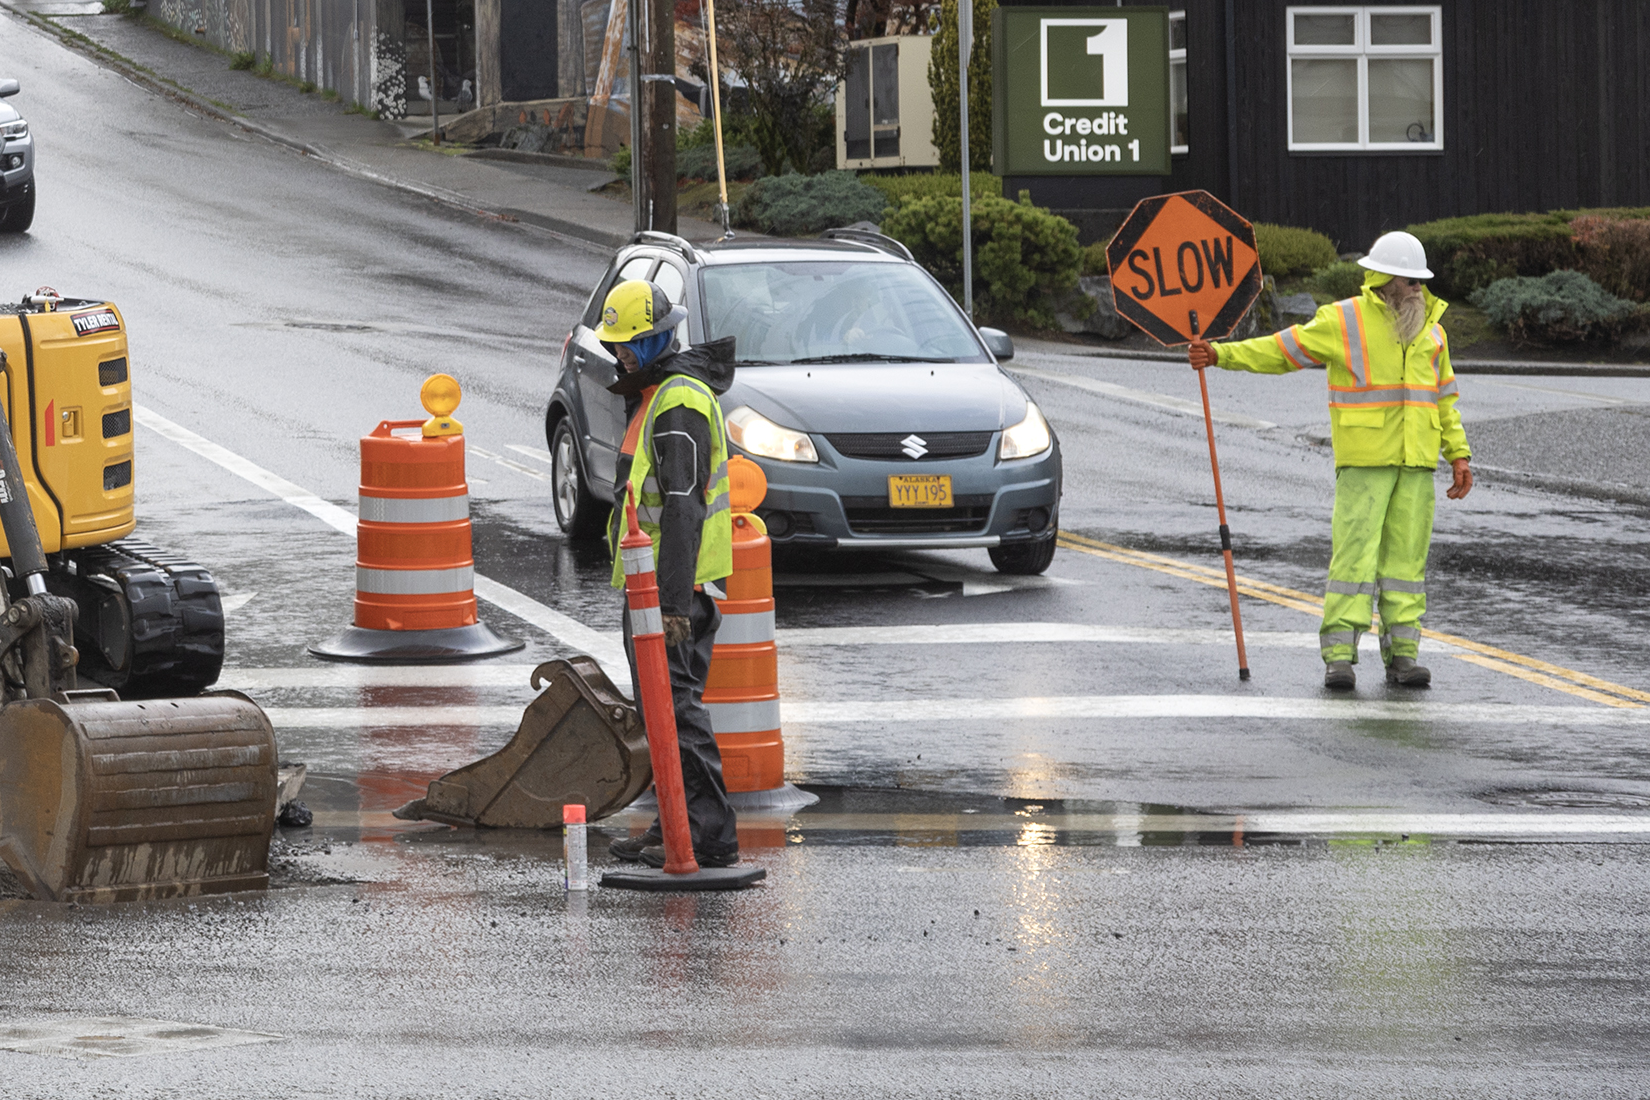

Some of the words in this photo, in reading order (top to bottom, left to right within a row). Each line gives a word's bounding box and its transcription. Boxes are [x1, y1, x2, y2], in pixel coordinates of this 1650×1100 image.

[1043, 111, 1129, 135] Credit
[1043, 138, 1121, 162] Union
[1127, 138, 1140, 162] 1
[1127, 235, 1234, 301] SLOW
[73, 314, 100, 332] TYLER
[895, 484, 919, 501] YYY
[924, 484, 947, 501] 195
